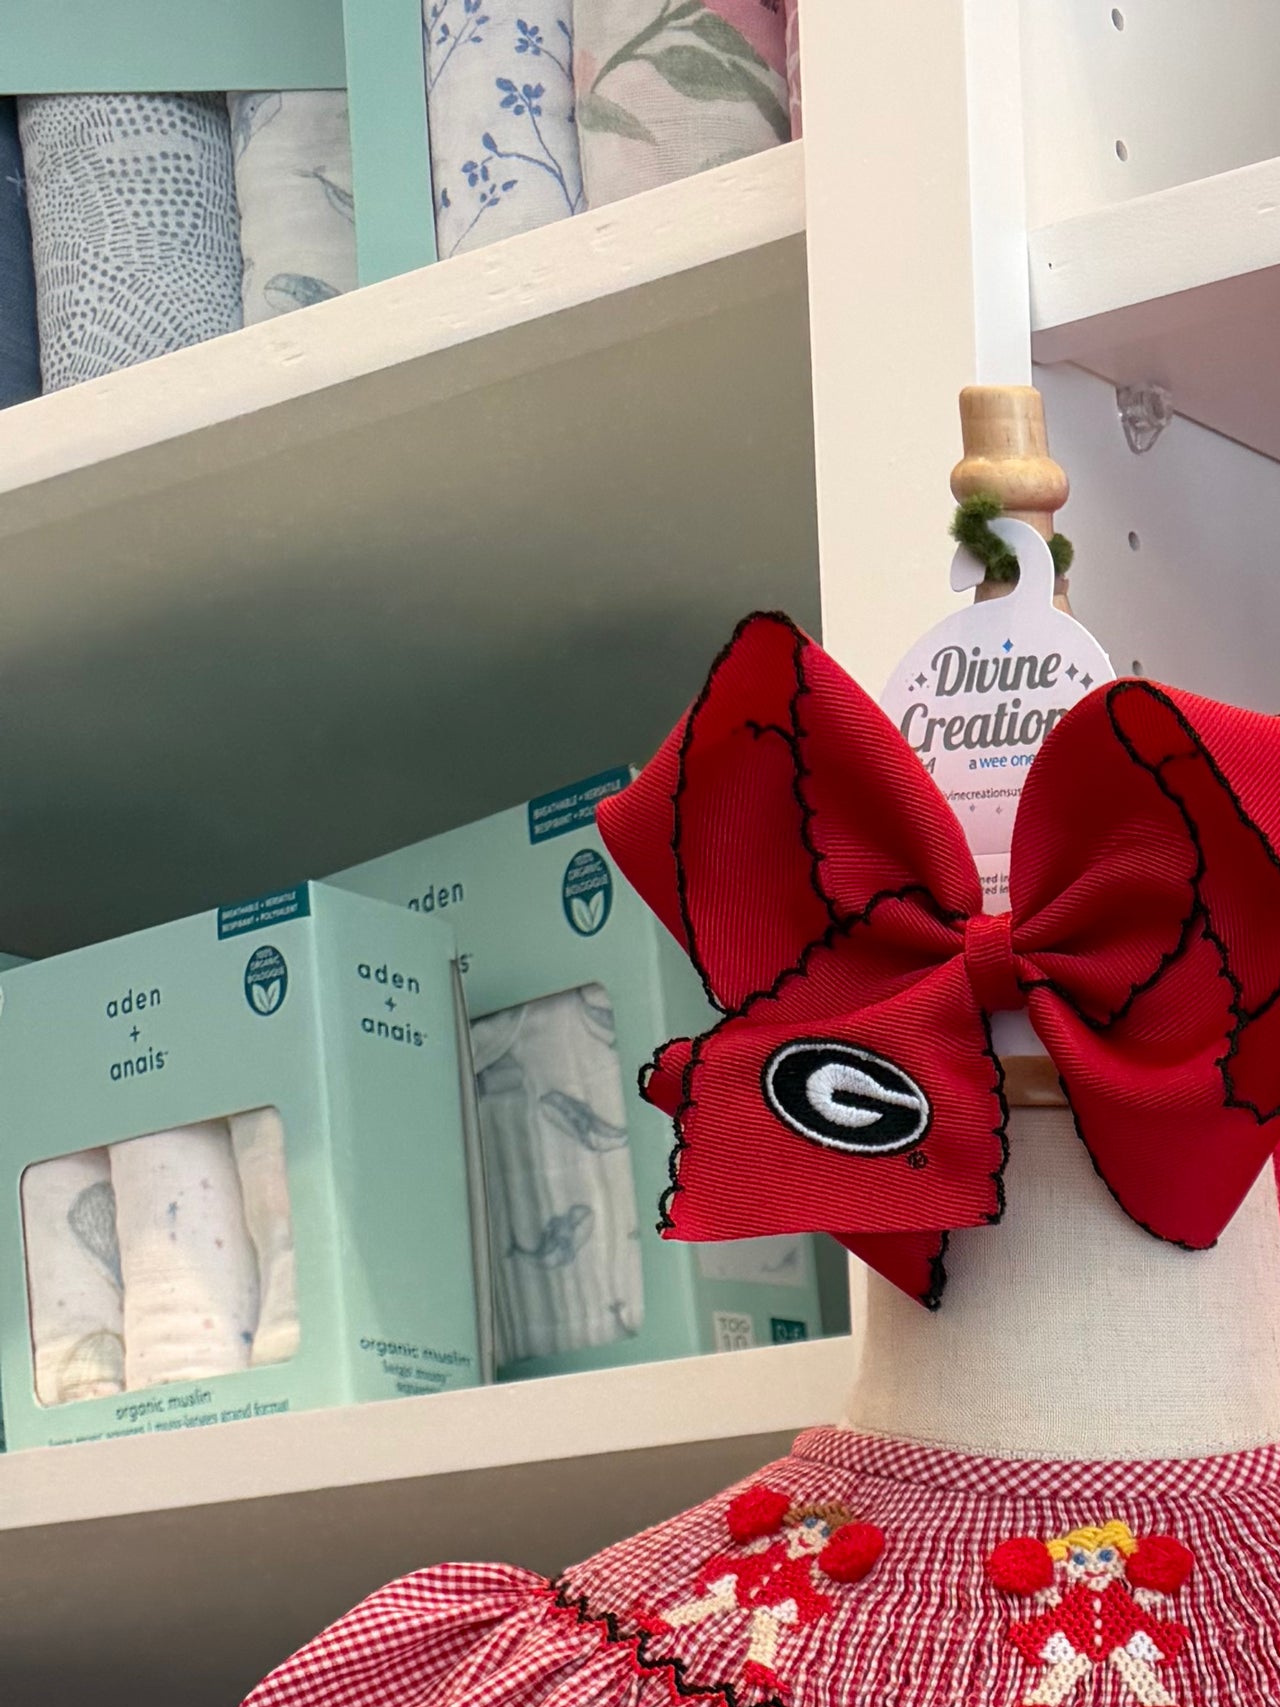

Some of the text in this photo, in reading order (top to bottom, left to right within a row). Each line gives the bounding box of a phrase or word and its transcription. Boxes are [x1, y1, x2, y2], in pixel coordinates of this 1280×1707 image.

[931, 645, 1062, 697] Divine
[969, 759, 977, 770] a
[980, 757, 1007, 769] wee
[357, 963, 420, 994] aden
[106, 987, 161, 1018] aden
[361, 1017, 423, 1047] anais
[109, 1046, 162, 1081] anais
[115, 1388, 212, 1422] organic muslin
